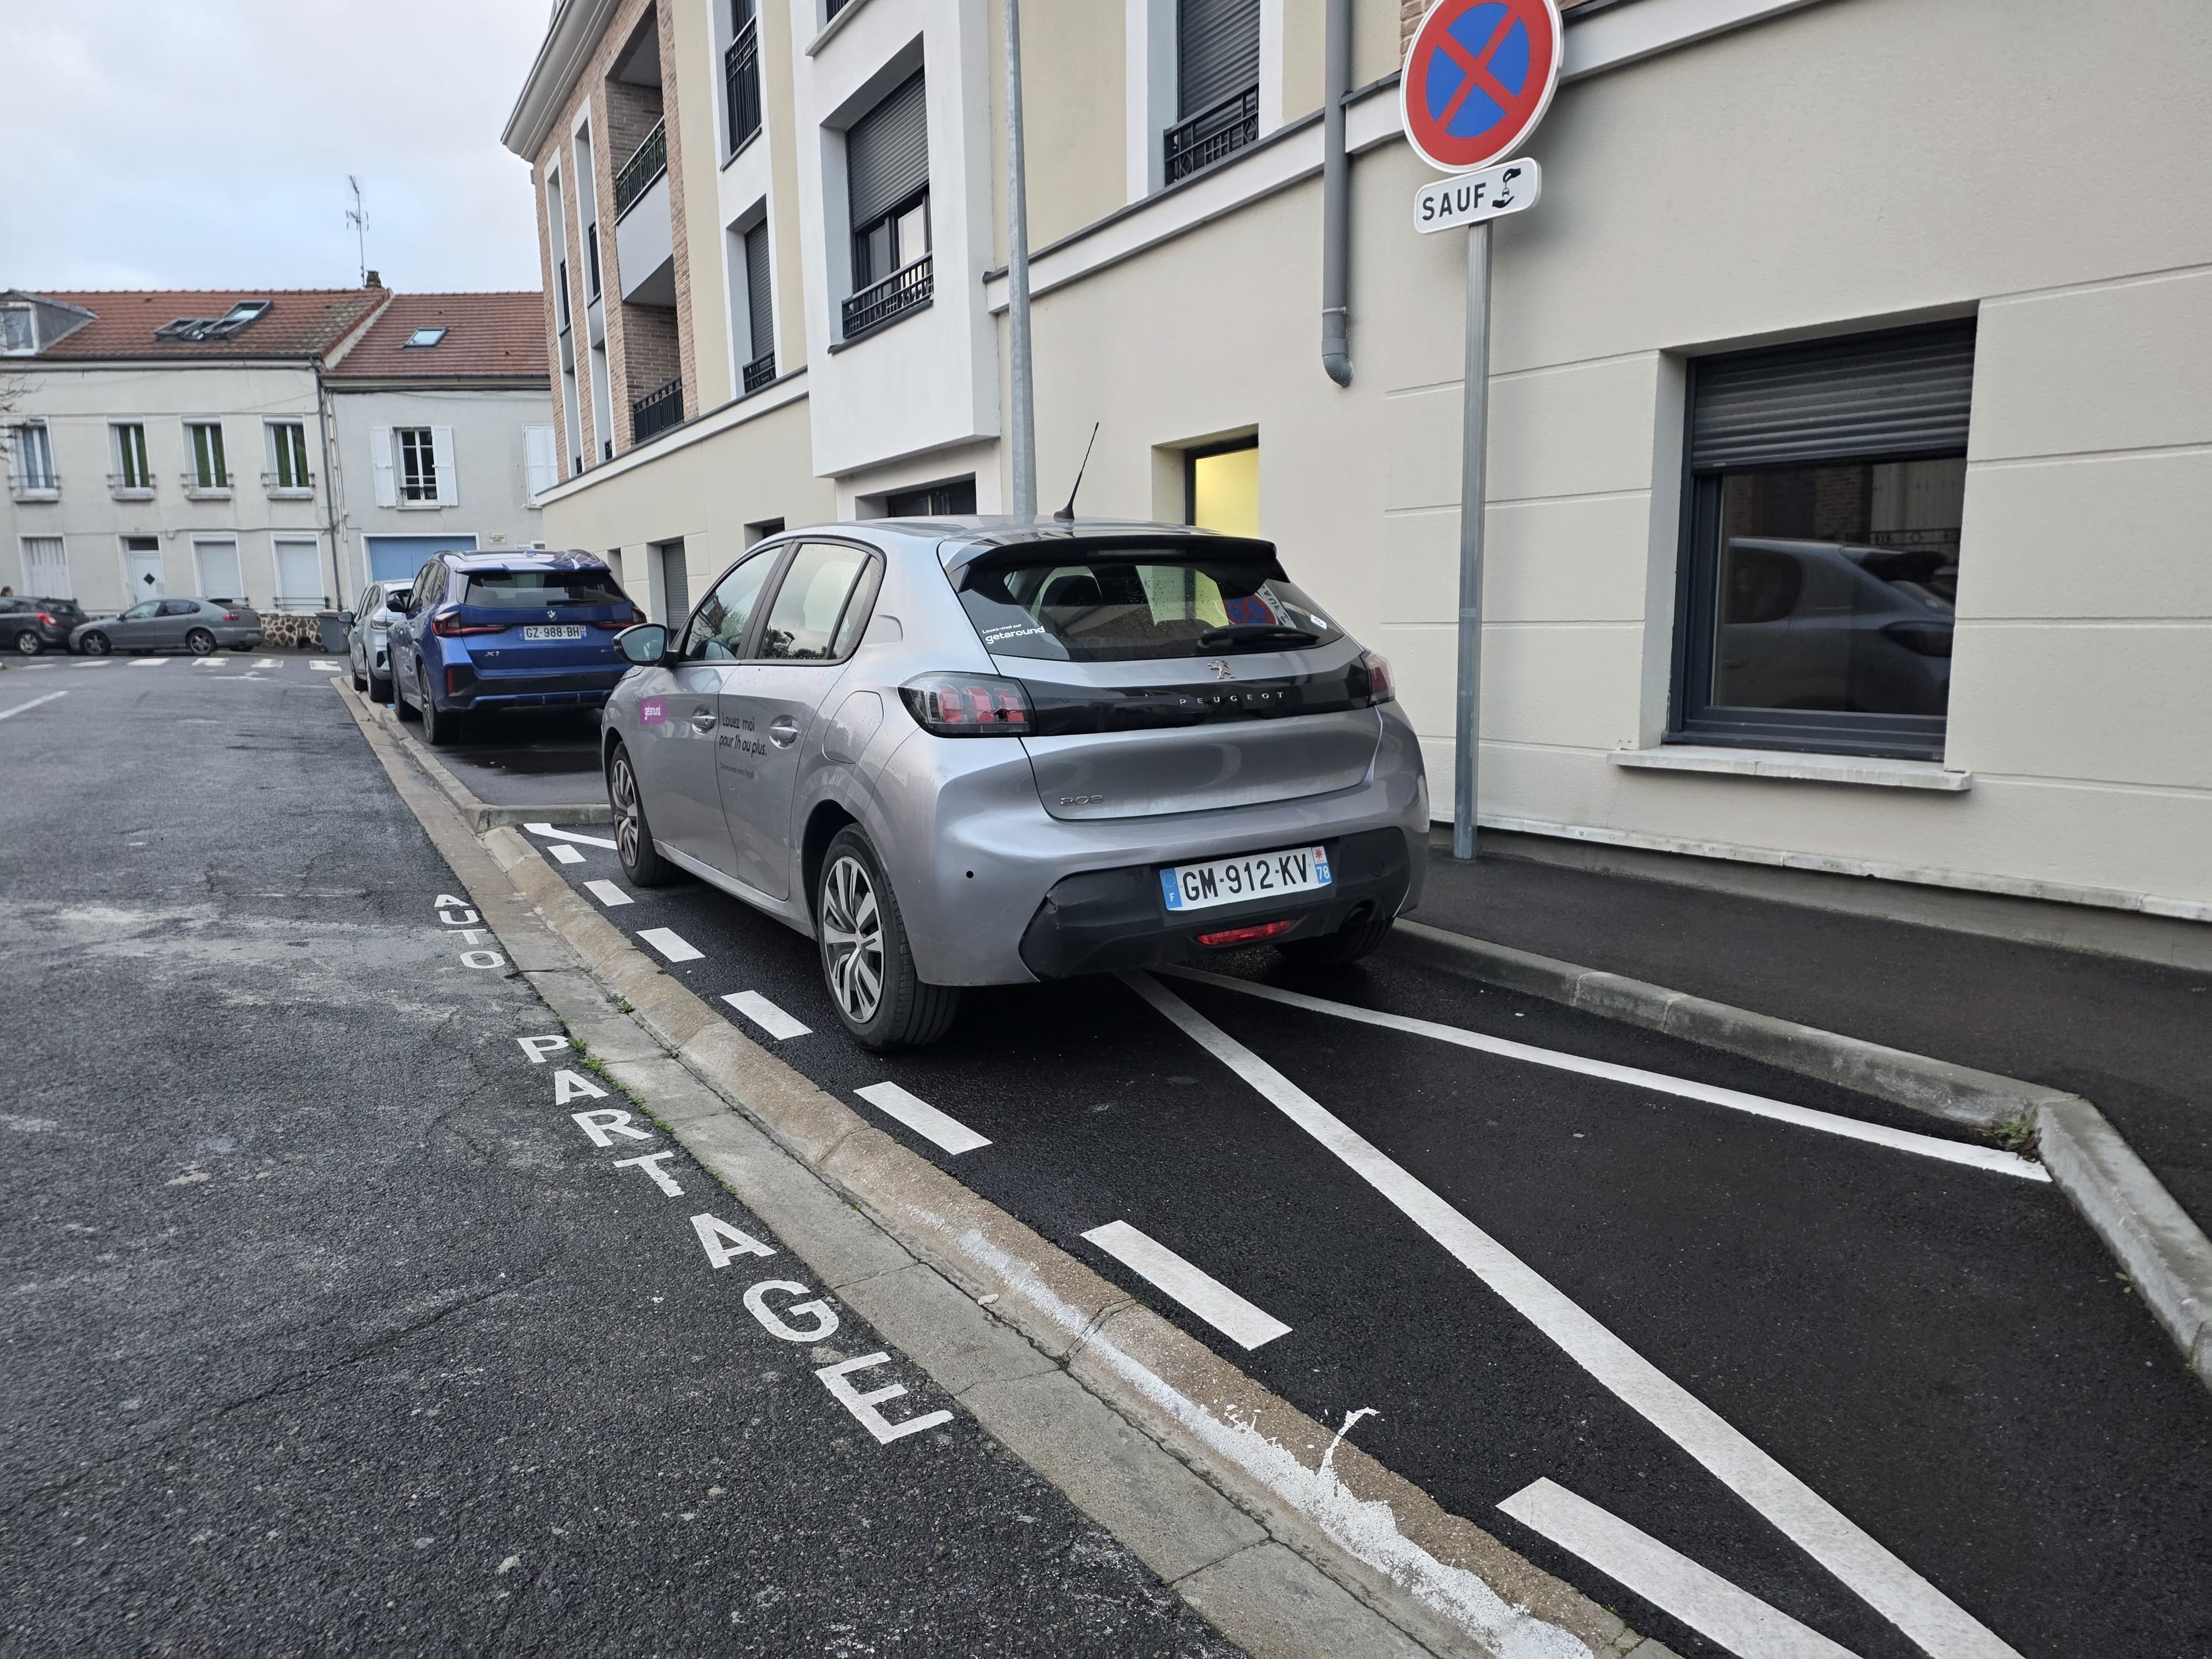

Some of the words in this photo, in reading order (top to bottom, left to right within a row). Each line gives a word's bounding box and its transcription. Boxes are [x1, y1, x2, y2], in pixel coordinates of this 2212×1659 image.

[1422, 181, 1486, 221] SAUF
[526, 627, 580, 638] GZ-988-BH
[982, 624, 1013, 634] Louez-moi
[985, 625, 1046, 644] getaround
[1179, 691, 1284, 705] PEUGEOT
[722, 711, 740, 729] Louez
[742, 716, 754, 732] moi
[719, 735, 734, 750] pour
[734, 734, 741, 750] 1h
[742, 740, 752, 752] ou
[751, 738, 766, 758] plus.
[1060, 794, 1103, 806] 208
[1169, 892, 1175, 902] F
[1182, 853, 1307, 901] GM-912-KV
[1316, 865, 1331, 880] 78
[434, 894, 506, 969] AUTO
[517, 1035, 954, 1444] PARTAGE
